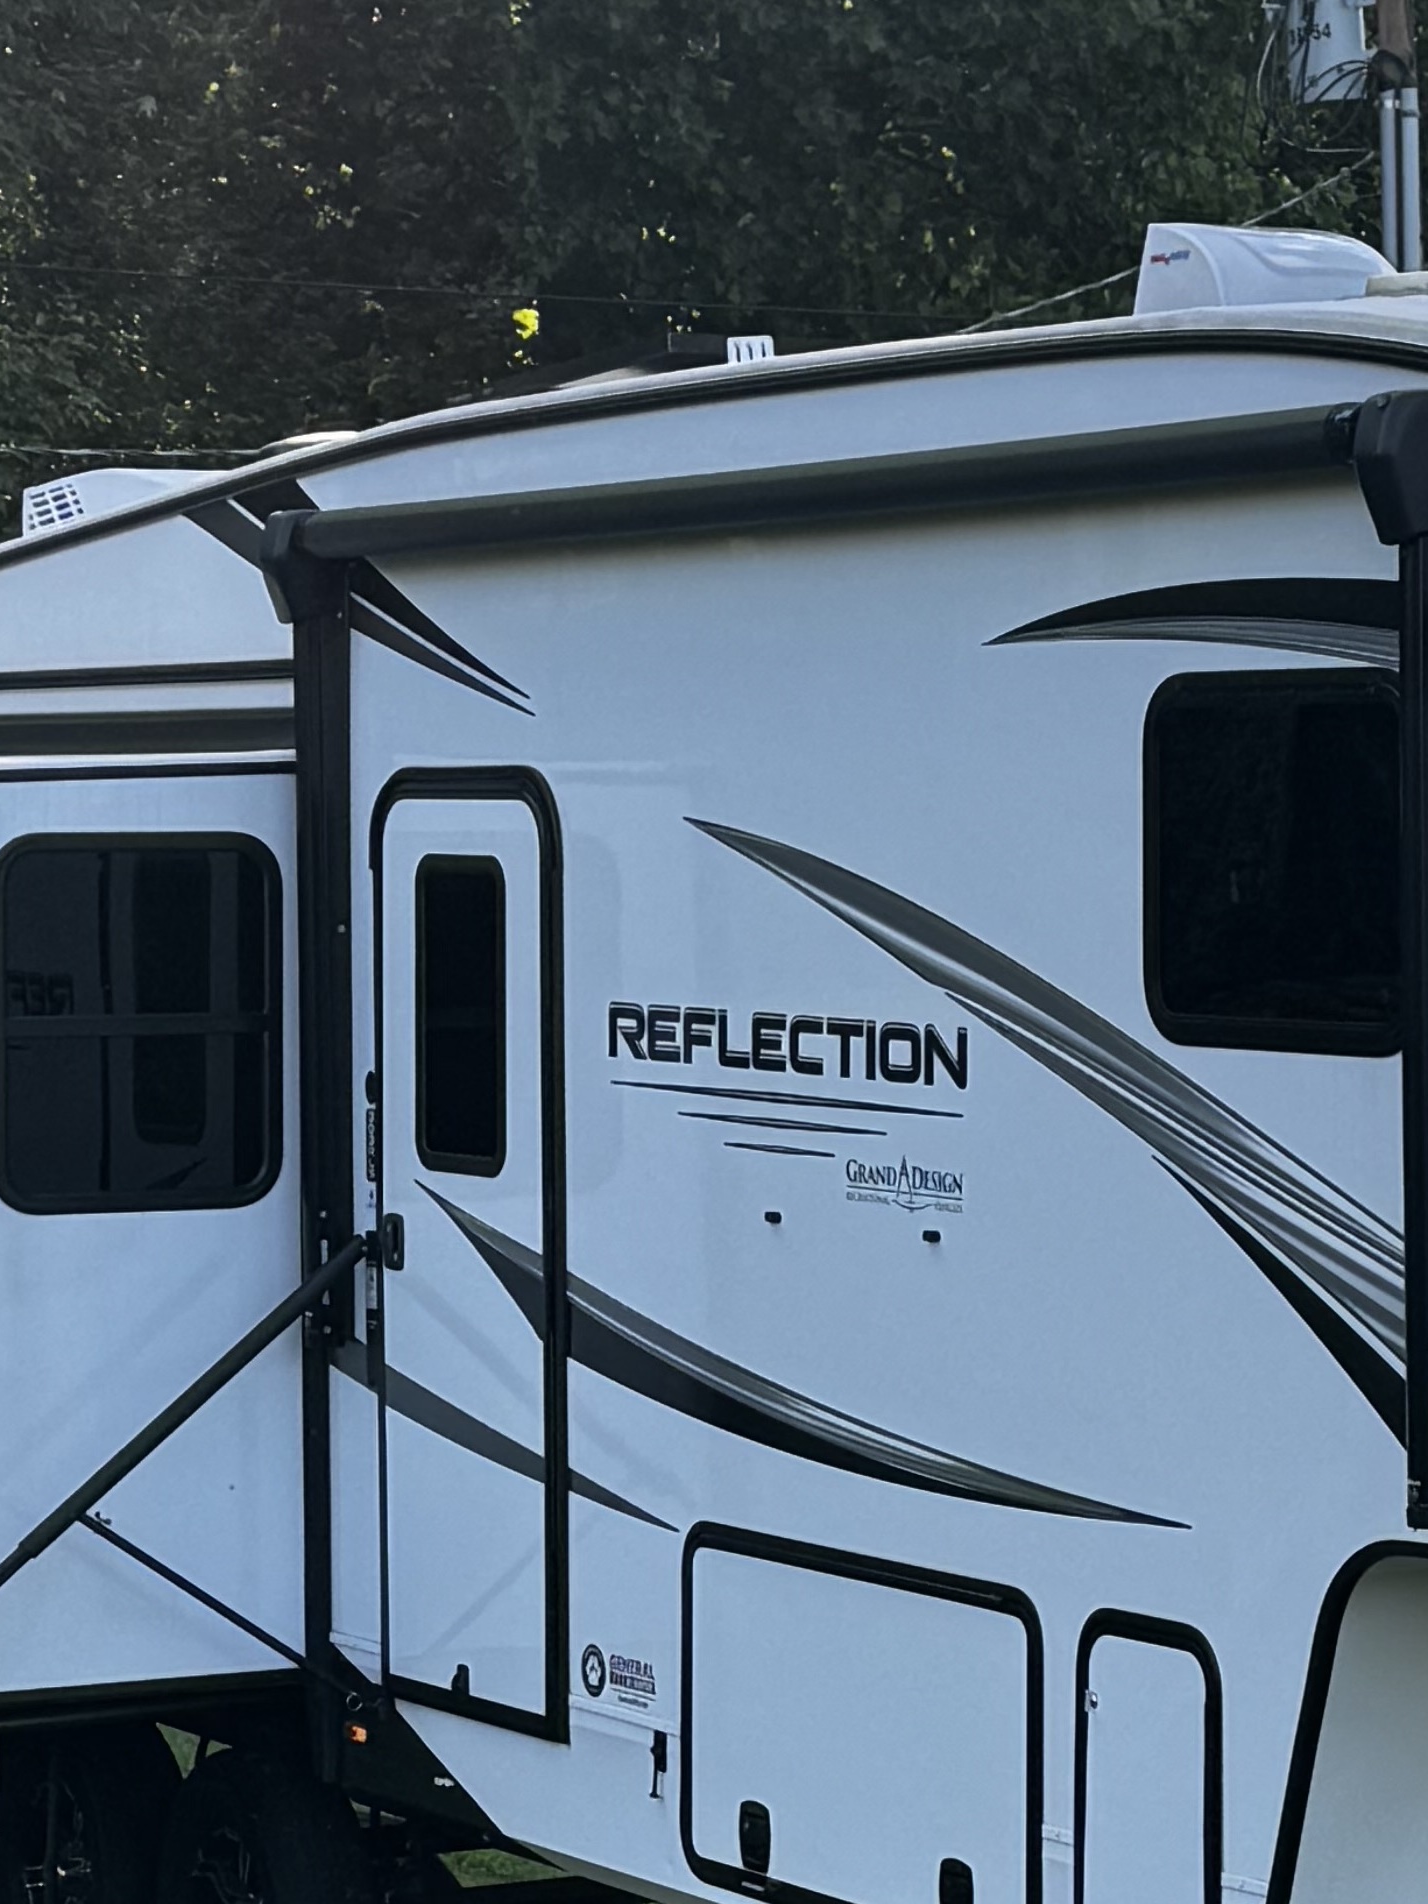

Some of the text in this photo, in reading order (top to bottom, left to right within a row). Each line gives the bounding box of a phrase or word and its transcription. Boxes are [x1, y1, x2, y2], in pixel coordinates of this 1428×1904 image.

[608, 1001, 968, 1090] REFLECTION
[845, 1159, 964, 1195] GRAND DESIGN
